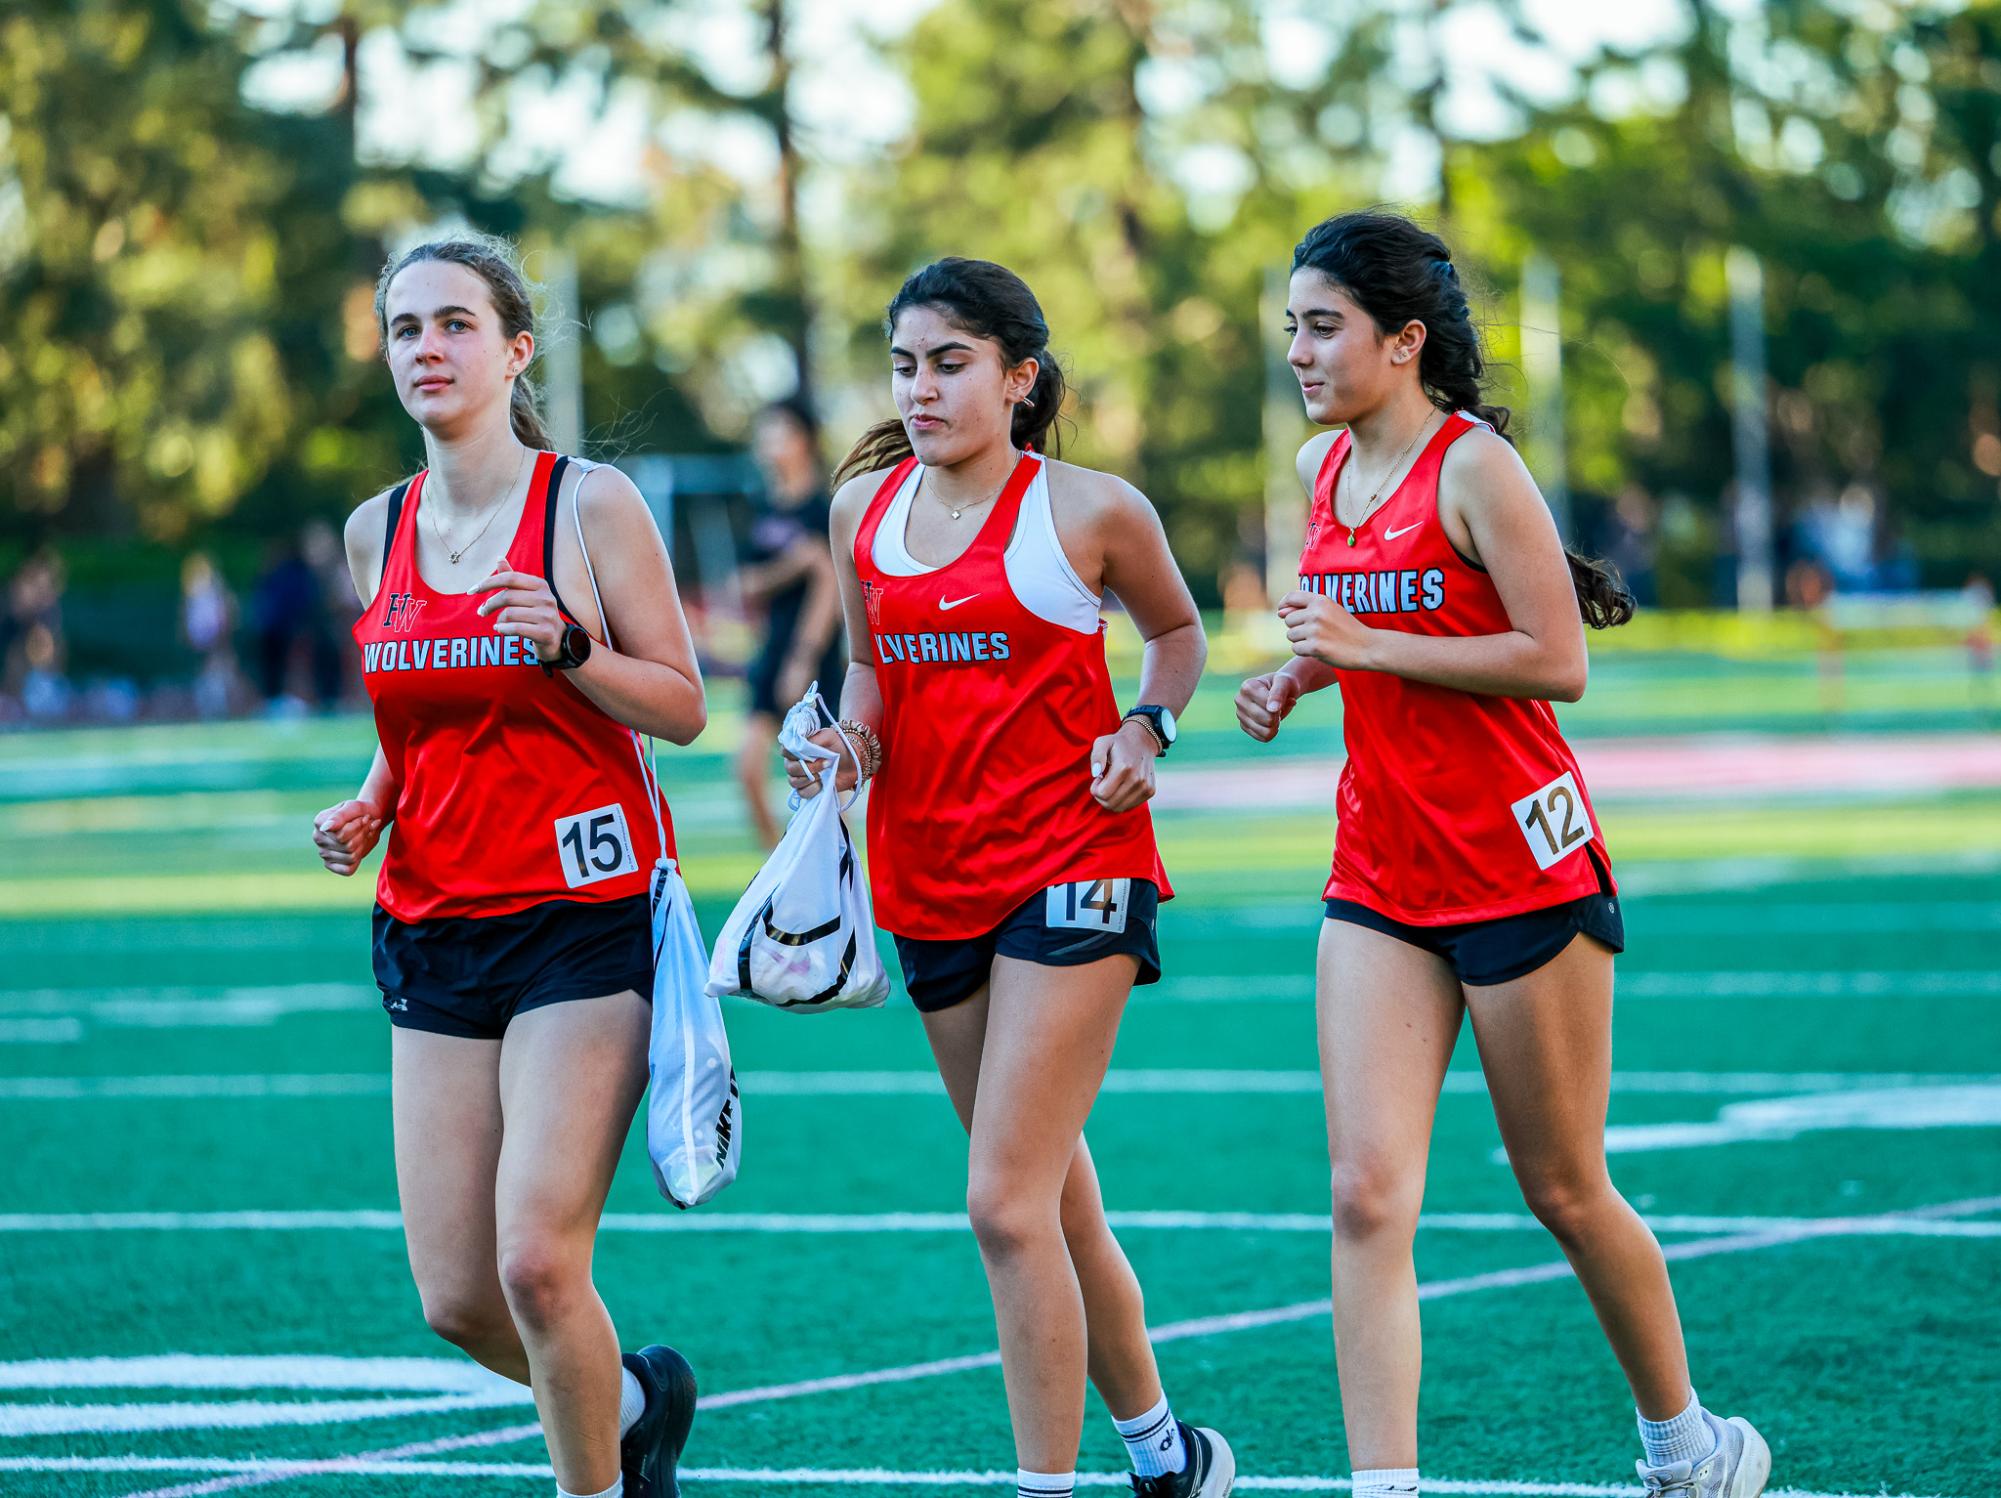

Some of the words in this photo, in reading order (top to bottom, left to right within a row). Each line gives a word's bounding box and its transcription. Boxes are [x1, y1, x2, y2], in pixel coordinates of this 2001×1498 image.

[1299, 567, 1445, 614] VERINES
[365, 635, 541, 672] WOLVERINES
[875, 632, 1010, 664] LVERINES
[1525, 786, 1585, 855] 12
[562, 813, 622, 878] 15
[1054, 878, 1117, 924] 14
